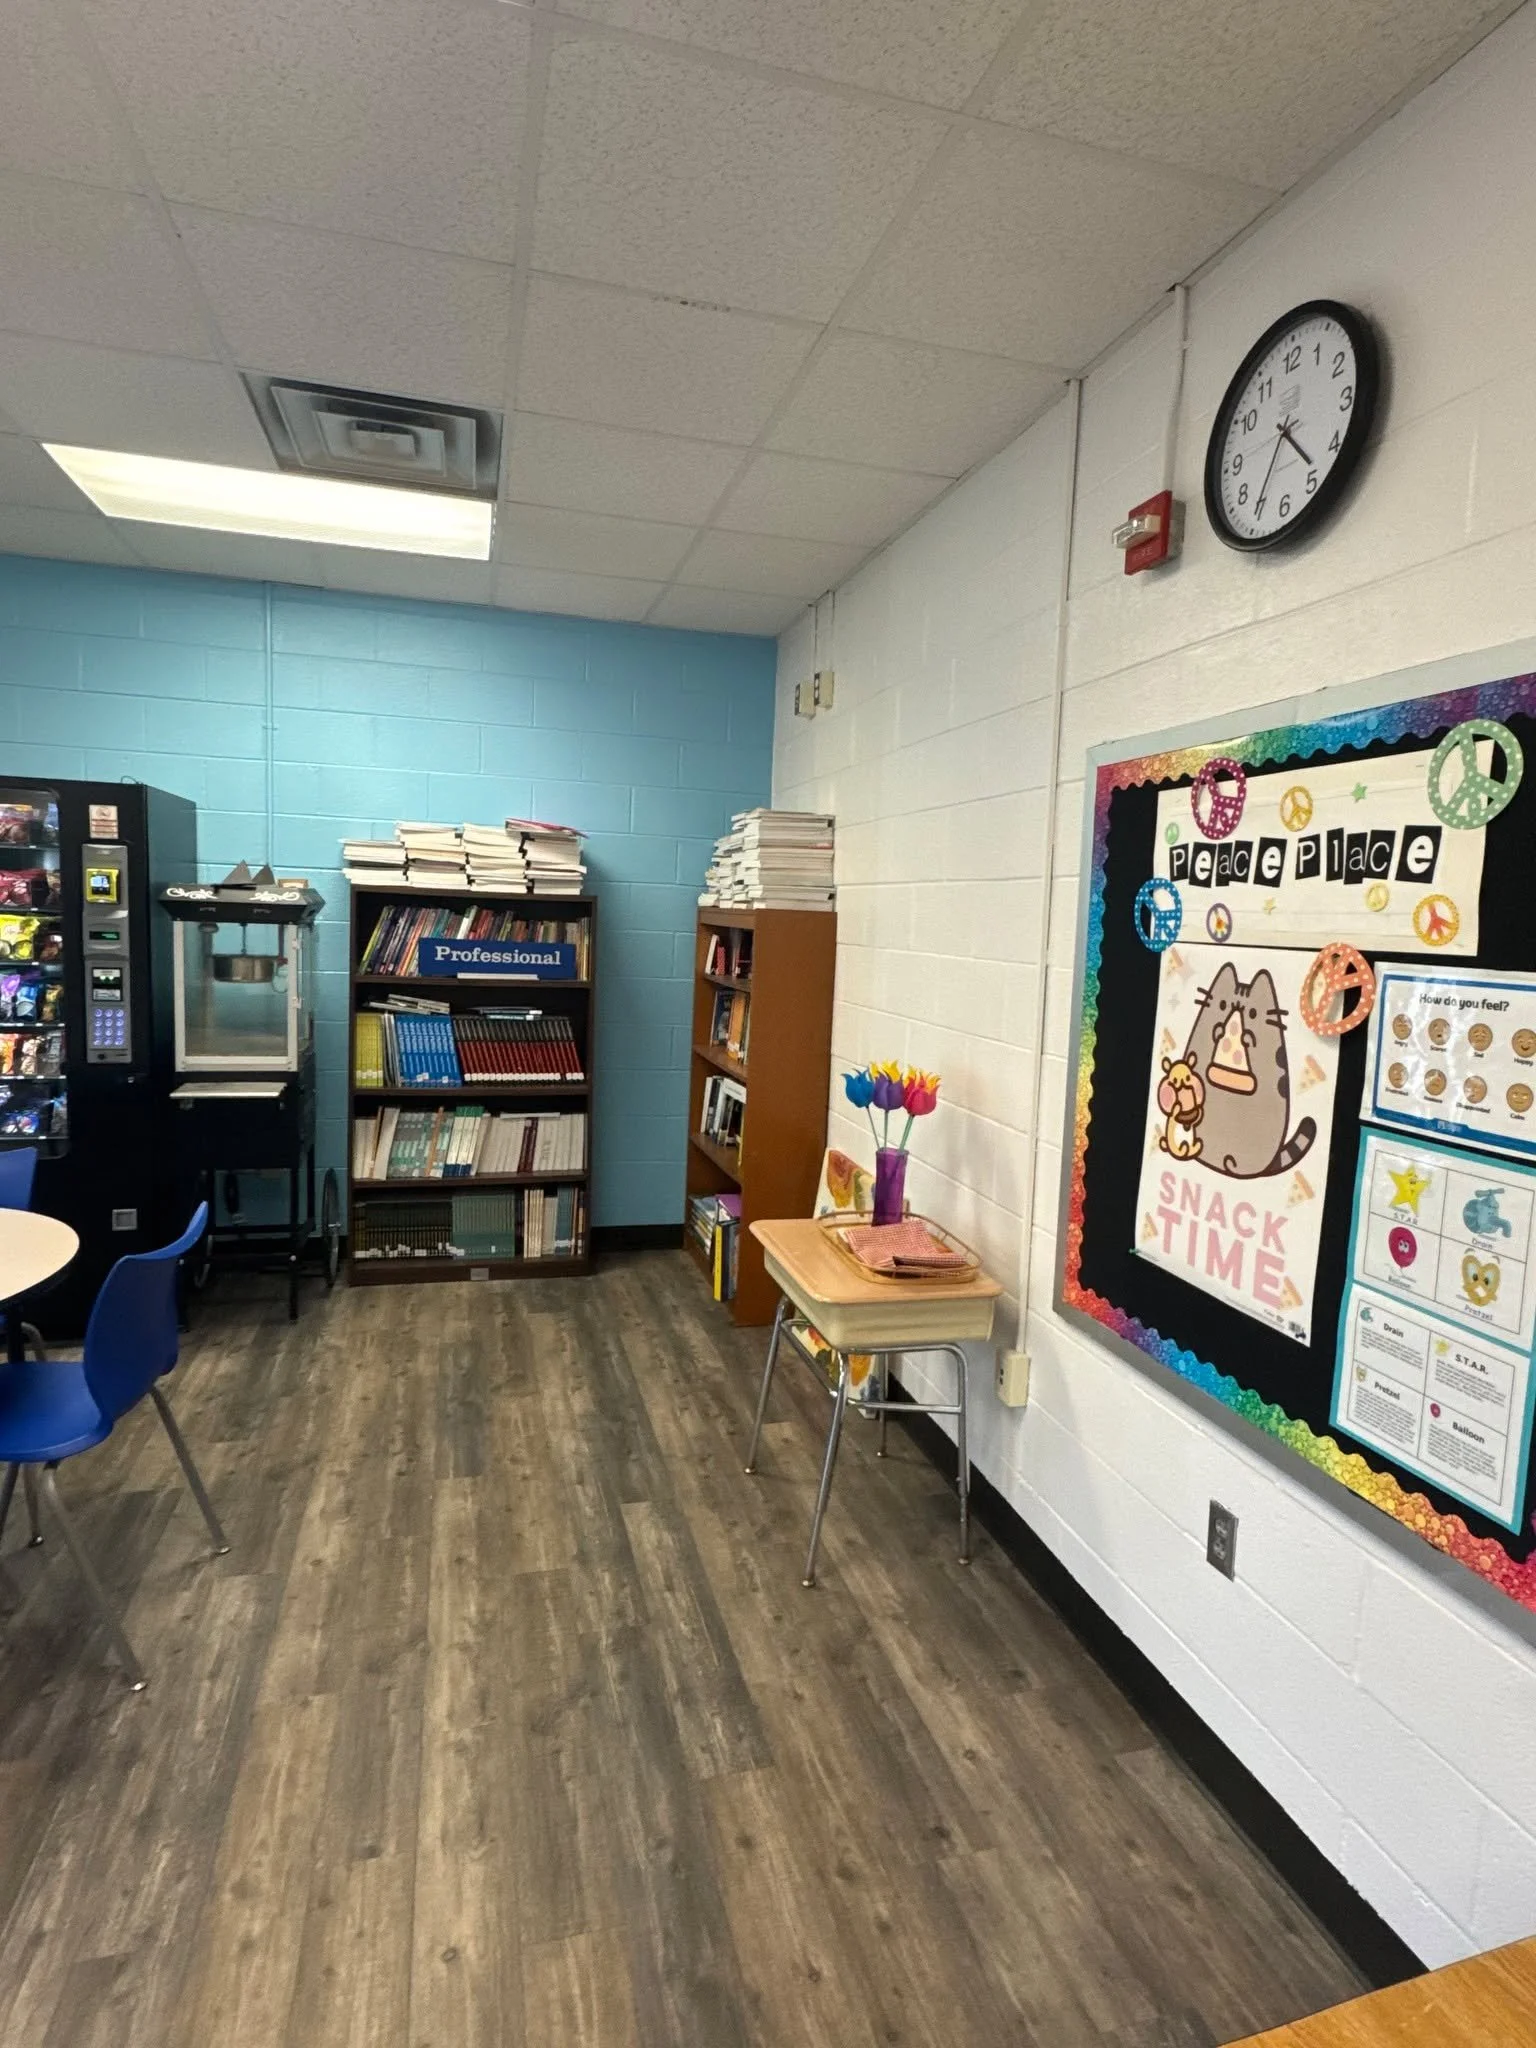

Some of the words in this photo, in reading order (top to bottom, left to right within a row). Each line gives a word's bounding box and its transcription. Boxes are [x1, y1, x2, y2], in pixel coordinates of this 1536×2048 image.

[1283, 345, 1302, 376] 12
[1313, 342, 1321, 366] 1
[1332, 351, 1346, 379] 2
[1258, 376, 1273, 403] 11
[1339, 386, 1353, 412] 3
[1241, 408, 1258, 436] 10
[1328, 429, 1341, 454] 4
[1232, 453, 1243, 477] 9
[1306, 468, 1318, 495] 5
[1238, 483, 1248, 505] 8
[1279, 494, 1290, 517] 6
[435, 946, 561, 965] Professional
[1419, 993, 1442, 1005] How
[1444, 996, 1457, 1006] do
[1459, 999, 1478, 1010] you
[1481, 999, 1510, 1011] feel?
[1159, 1171, 1289, 1254] SNACK
[1157, 1204, 1285, 1310] TIME
[1464, 1304, 1493, 1320] Pretzel
[1383, 1322, 1404, 1338] Drain
[1455, 1353, 1489, 1375] S.T.A.R.
[1374, 1381, 1400, 1401] Pretzel
[1452, 1421, 1485, 1444] Balloon
